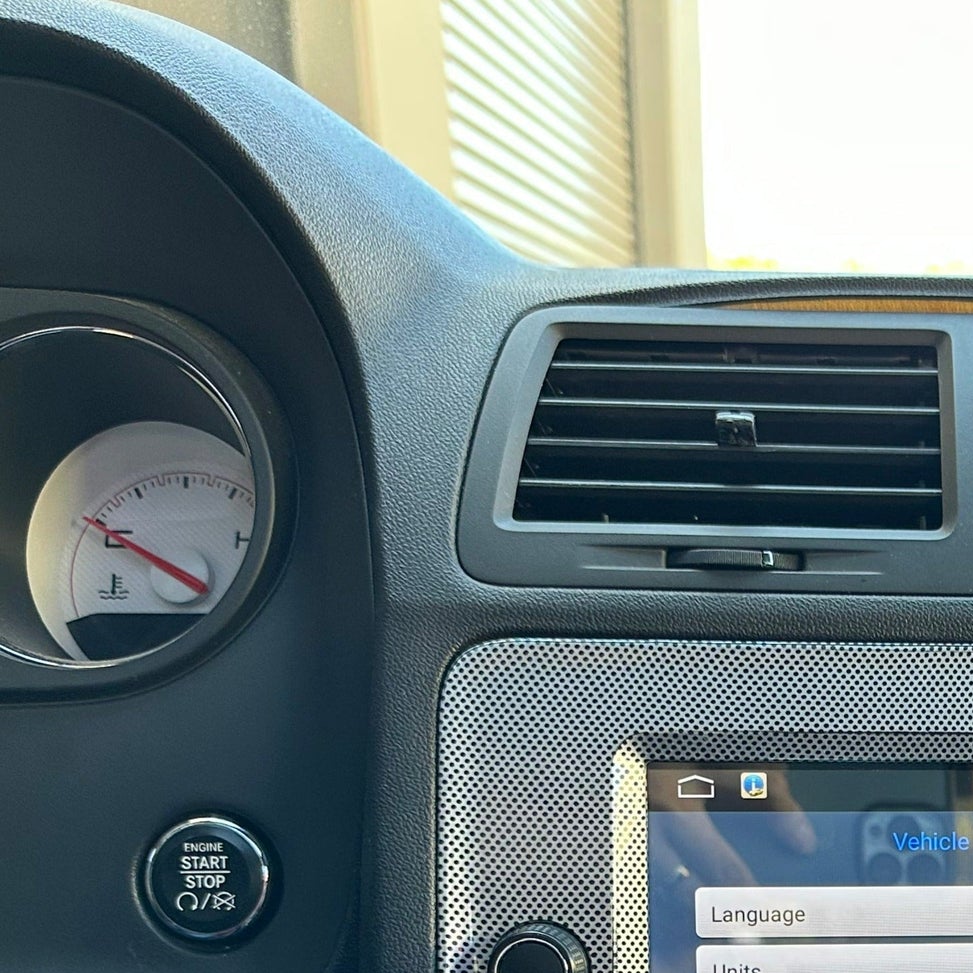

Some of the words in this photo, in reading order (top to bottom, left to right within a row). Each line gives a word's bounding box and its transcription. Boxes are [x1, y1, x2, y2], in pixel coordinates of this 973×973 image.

[183, 842, 224, 853] ENGINE
[892, 831, 971, 852] Vehicle
[180, 856, 229, 870] START
[185, 875, 226, 889] STOP
[710, 905, 807, 928] Language
